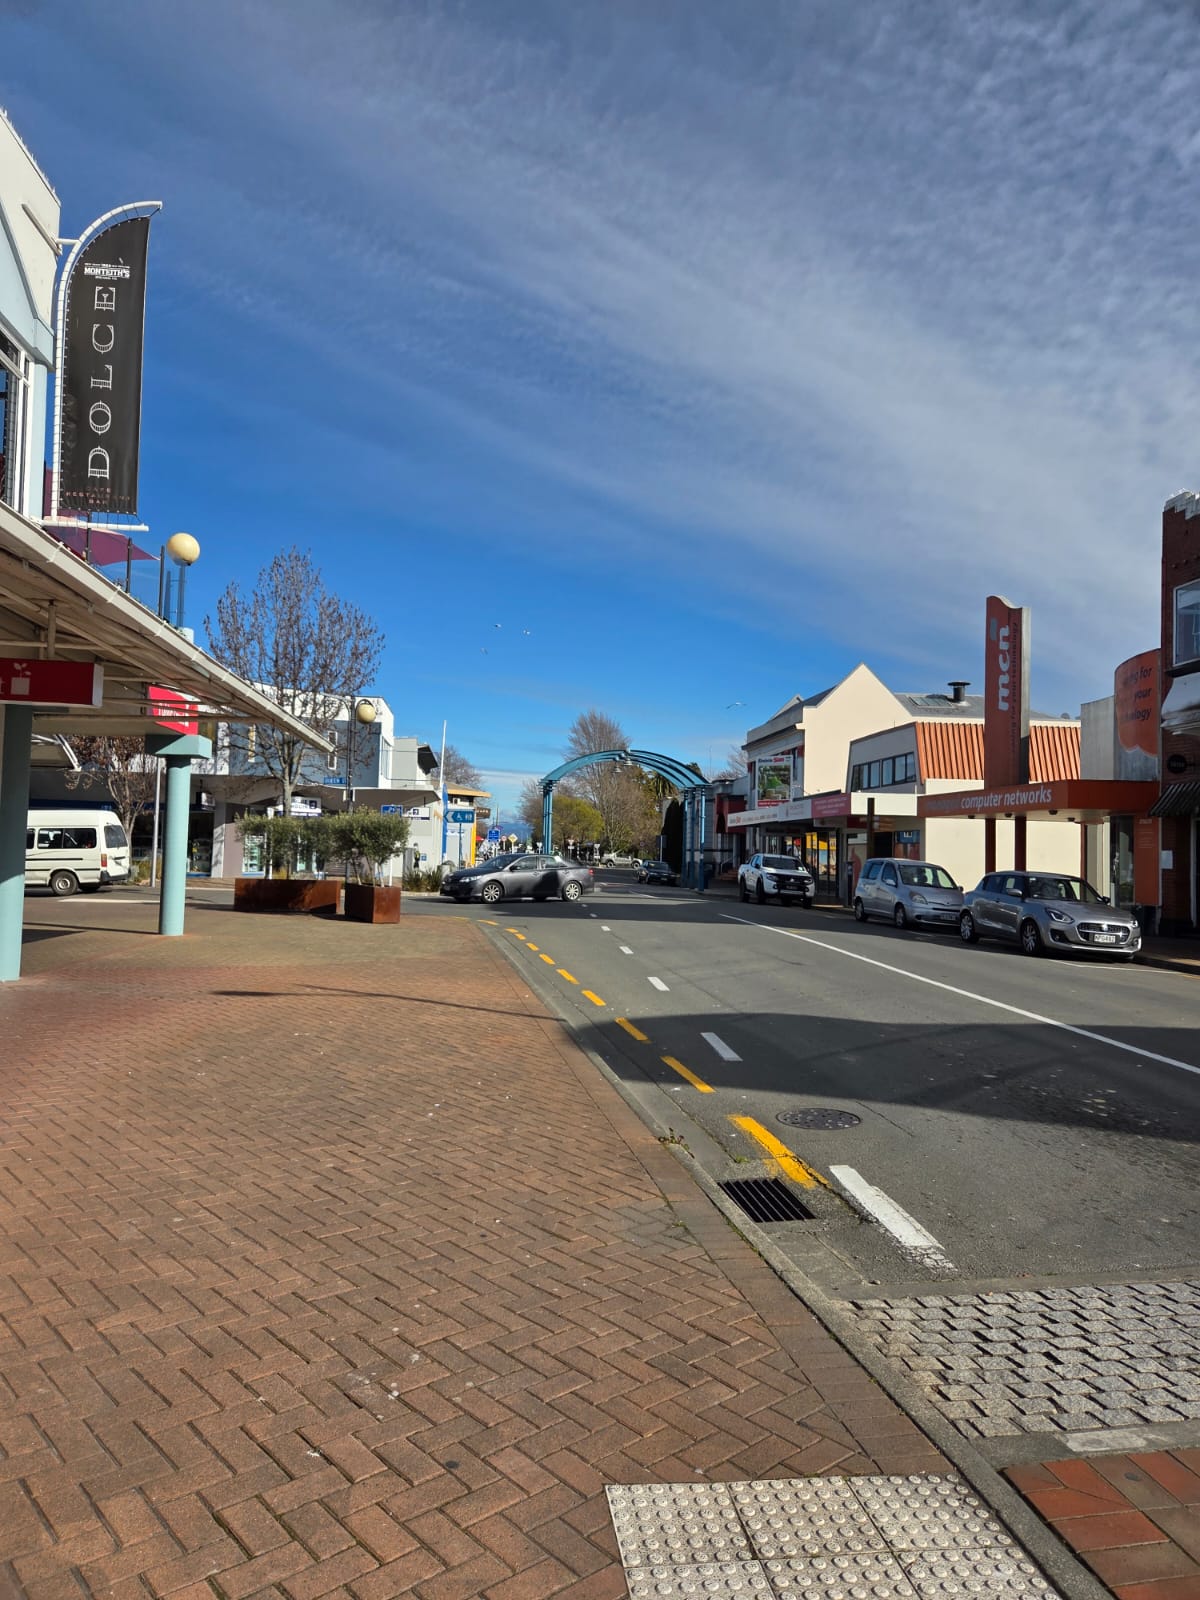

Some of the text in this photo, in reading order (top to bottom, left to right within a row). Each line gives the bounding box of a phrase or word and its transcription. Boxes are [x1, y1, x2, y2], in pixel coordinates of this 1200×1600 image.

[84, 267, 130, 279] MONTEITH'S
[87, 285, 116, 479] DOLCE
[998, 624, 1010, 711] mcn
[1140, 667, 1153, 679] for
[960, 790, 1004, 812] computer
[1003, 785, 1053, 805] networks
